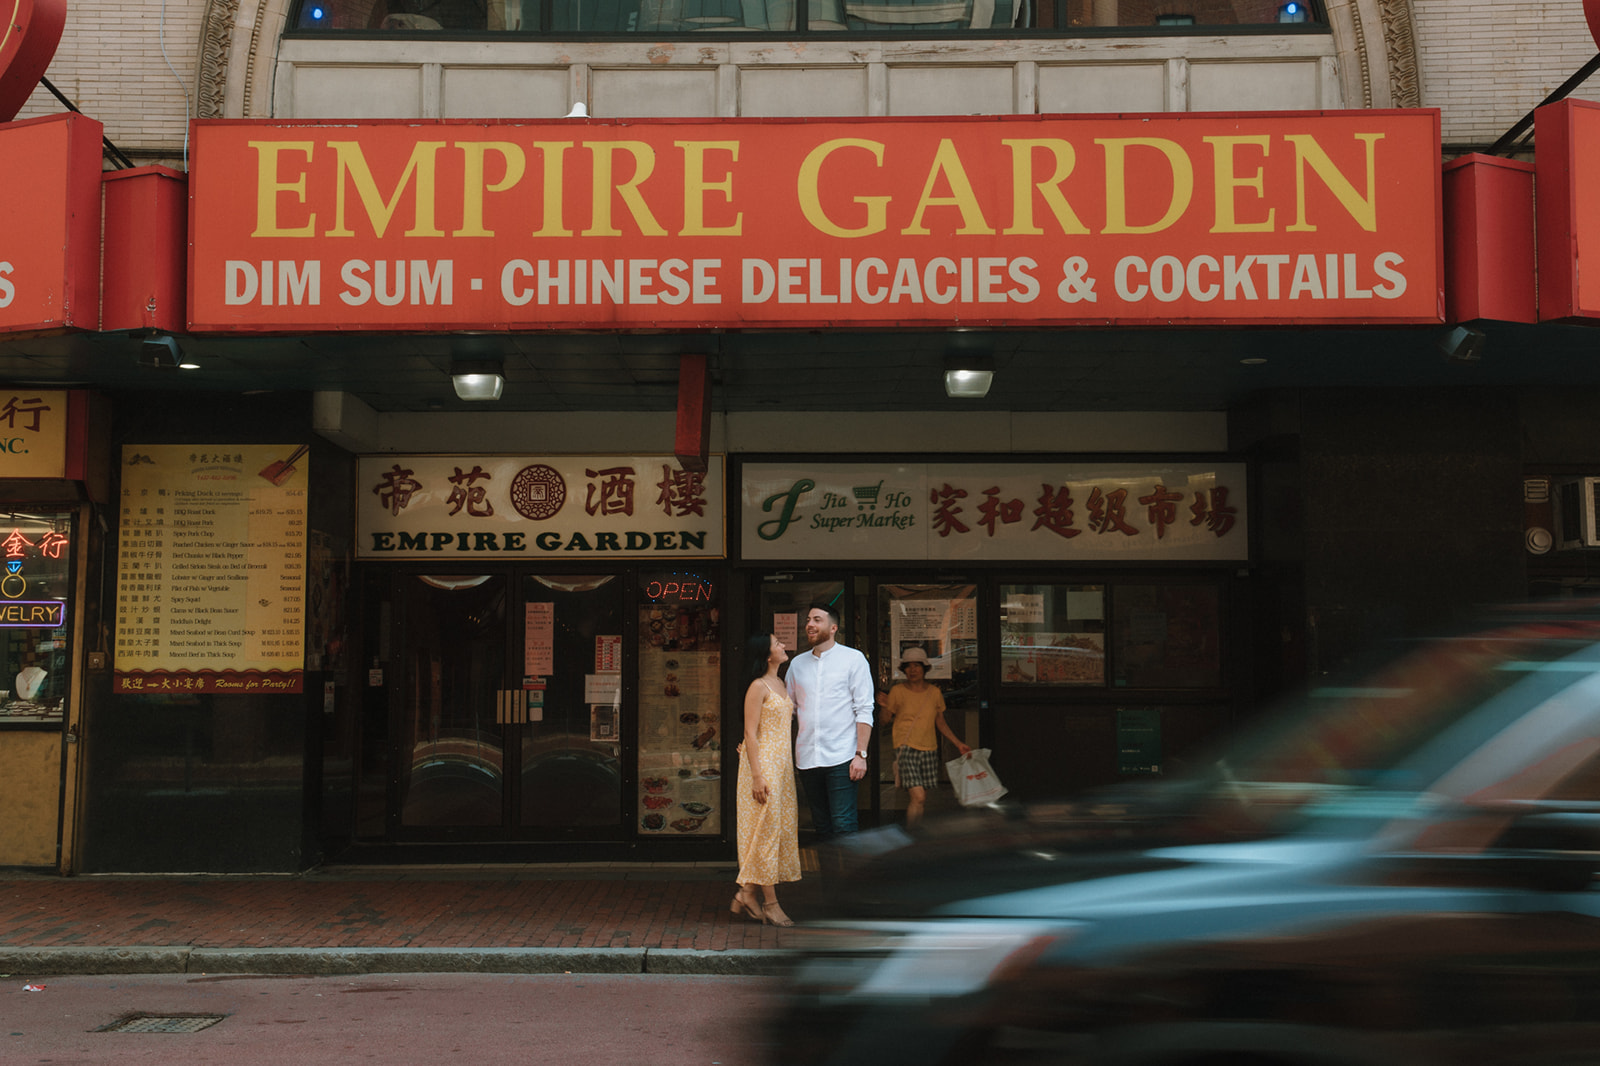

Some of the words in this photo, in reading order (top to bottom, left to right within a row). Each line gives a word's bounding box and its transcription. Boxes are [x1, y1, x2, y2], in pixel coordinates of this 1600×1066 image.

[248, 140, 744, 239] EMPIRE
[797, 132, 1386, 239] GARDEN
[224, 259, 321, 307] DIM
[339, 259, 453, 307] SUM
[501, 257, 723, 306] CHINESE
[742, 256, 1040, 305] DELICACIES
[1058, 255, 1097, 303] &
[1114, 251, 1408, 303] COCKTAILS
[820, 492, 848, 510] Jia
[884, 492, 912, 510] Ho
[930, 483, 1238, 539] 家和超級市場
[372, 532, 526, 551] EMPIRE
[536, 531, 707, 551] GARDEN
[646, 581, 712, 600] OPEN
[215, 679, 244, 688] Rooms
[245, 679, 259, 690] for
[262, 679, 296, 690] Party!!
